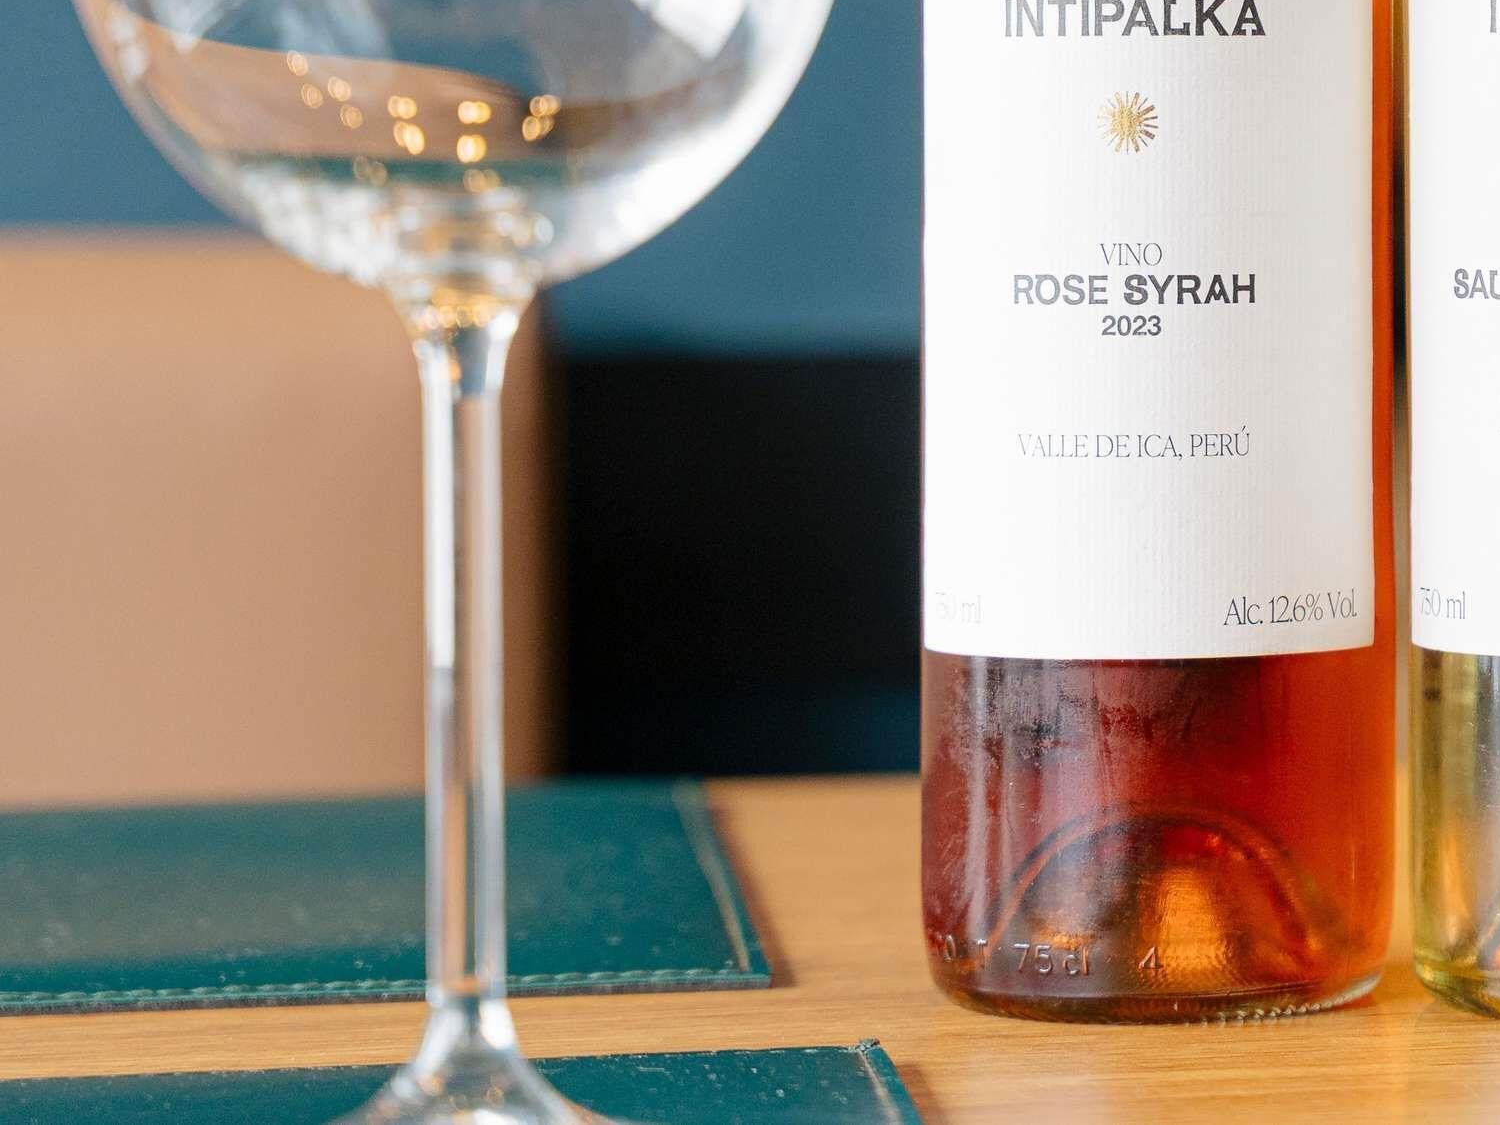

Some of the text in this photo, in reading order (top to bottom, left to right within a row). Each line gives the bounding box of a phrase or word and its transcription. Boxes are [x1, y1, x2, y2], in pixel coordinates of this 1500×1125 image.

[1099, 242, 1163, 267] VINO
[1012, 274, 1256, 306] ROSE SYRAH
[1101, 315, 1162, 337] 2023
[1017, 426, 1250, 460] VALLE DE ICA, PERÚ
[1223, 595, 1264, 626] Alc.
[1268, 593, 1324, 625] 12.6%
[1446, 591, 1466, 620] ml
